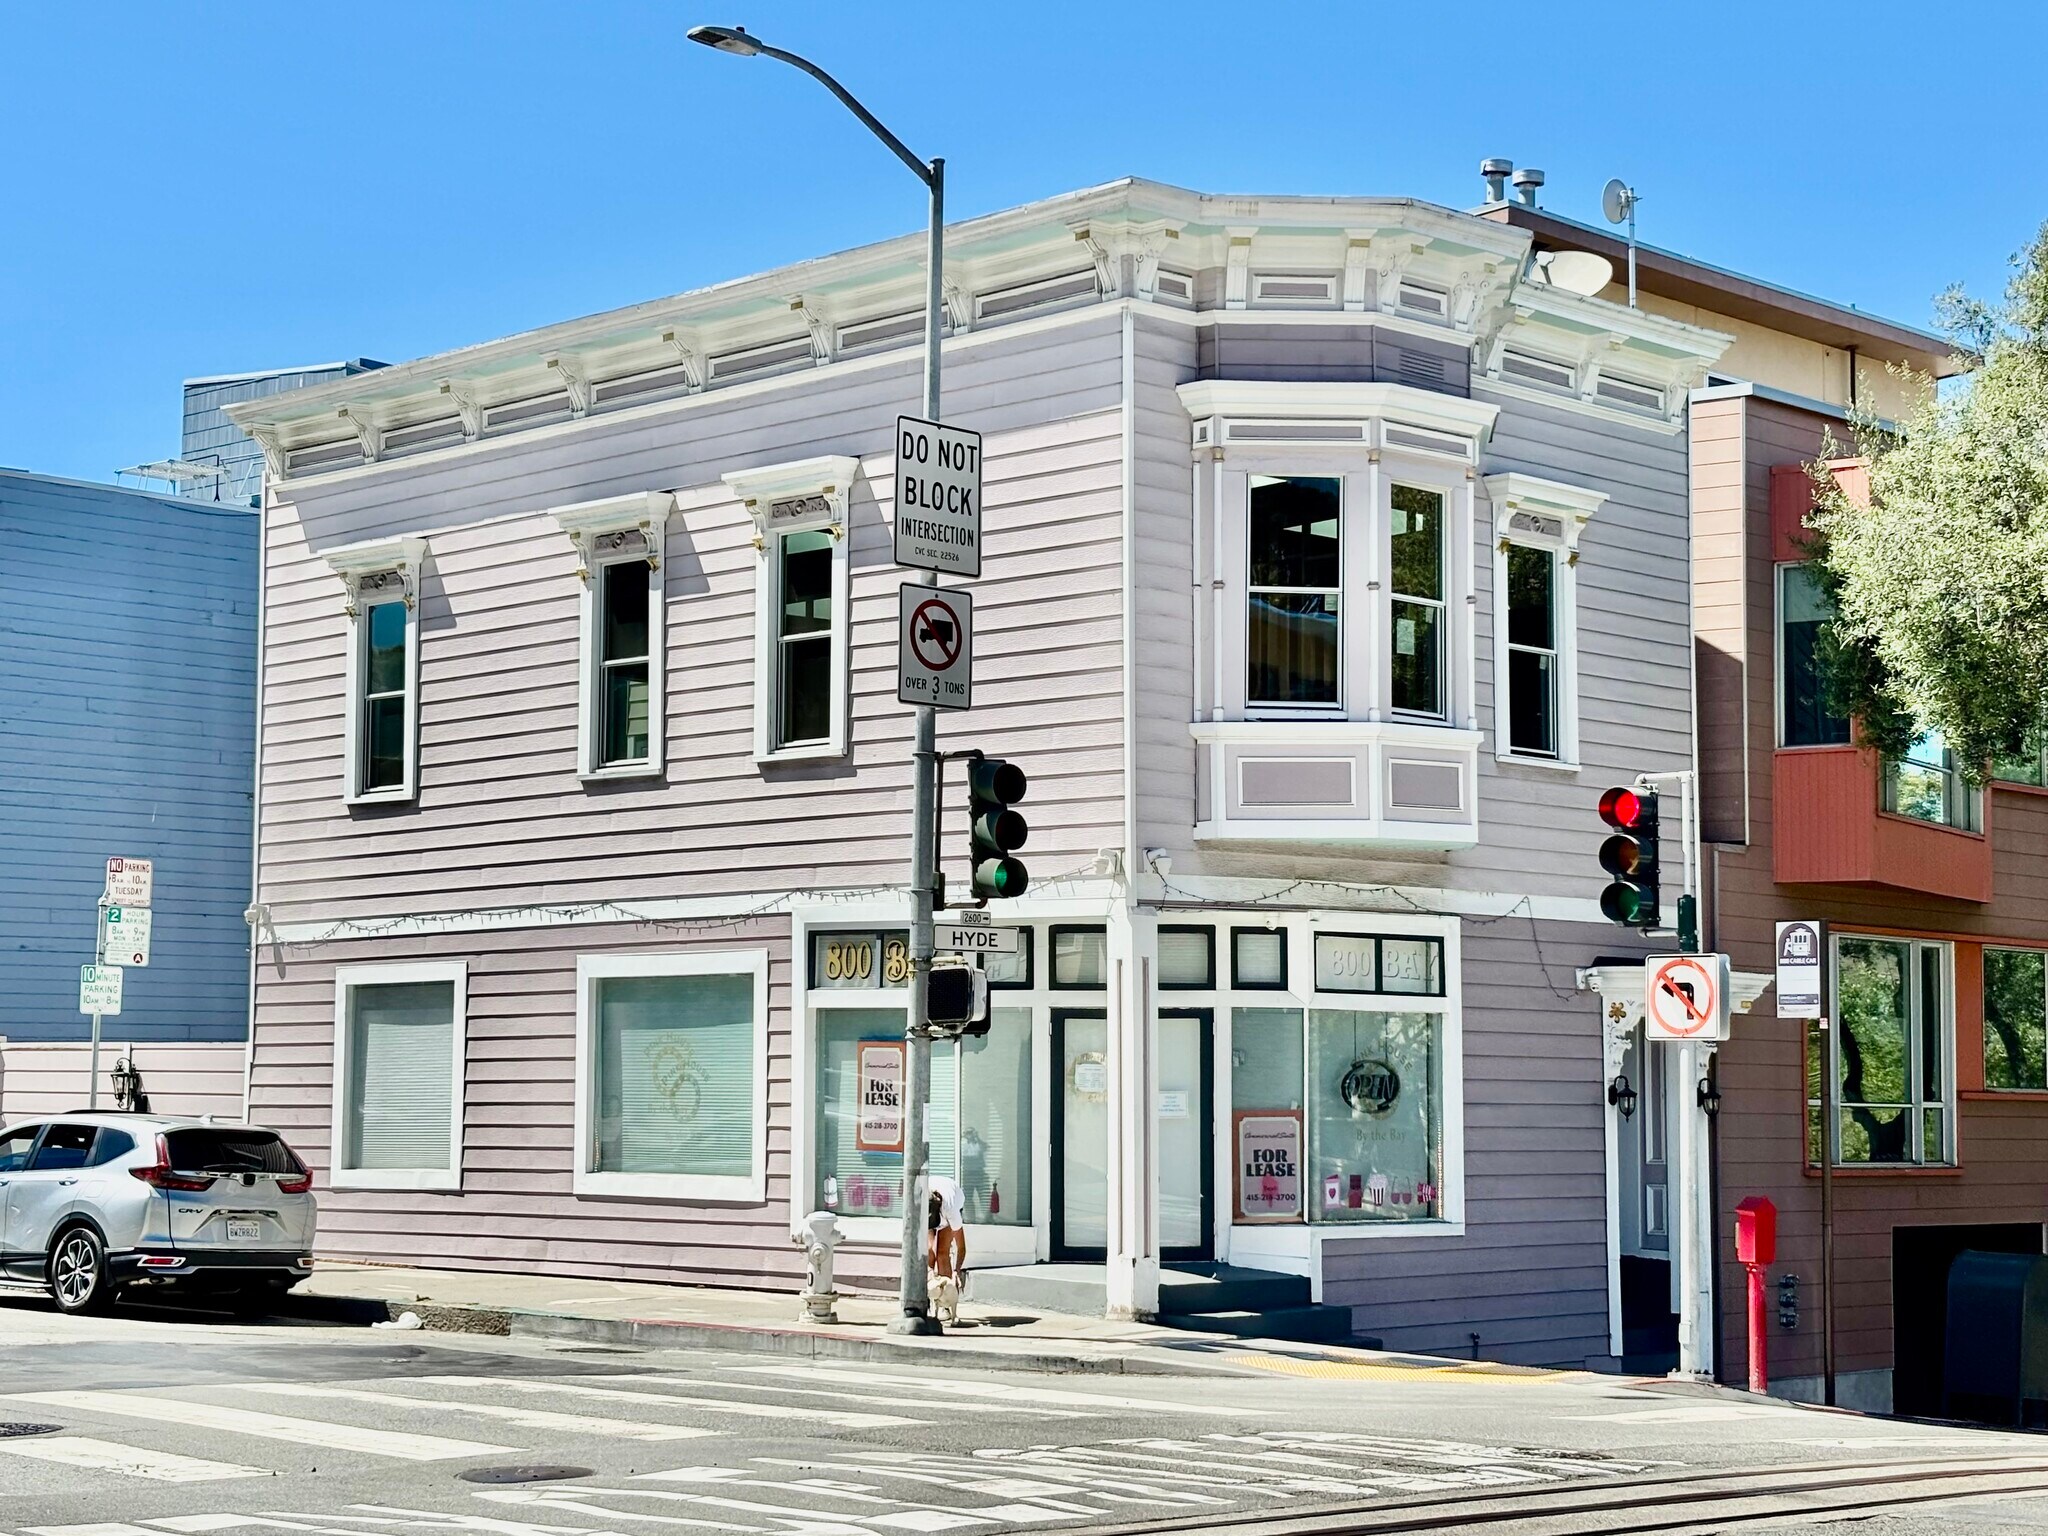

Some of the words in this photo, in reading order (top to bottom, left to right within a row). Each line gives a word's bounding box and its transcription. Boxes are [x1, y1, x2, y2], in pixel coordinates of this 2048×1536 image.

[902, 431, 929, 463] DO
[938, 438, 978, 474] NOT
[905, 476, 973, 517] BLOCK
[901, 516, 974, 548] INTERSECTION
[914, 546, 925, 556] CVC
[940, 551, 960, 562] 22526
[905, 675, 928, 692] OVER
[931, 676, 941, 695] 3
[944, 680, 966, 696] TONS
[110, 859, 122, 872] NO
[124, 863, 150, 874] PARKING
[115, 886, 144, 896] TUESDAY
[110, 909, 120, 921] 2
[122, 917, 149, 926] PARKING
[964, 912, 981, 923] 2600
[952, 930, 999, 948] HYDE
[134, 953, 142, 962] A
[825, 940, 873, 981] 800
[1333, 949, 1372, 977] 800
[1382, 949, 1440, 982] BAY
[83, 967, 95, 982] 10
[96, 973, 120, 983] MINUTE
[84, 984, 118, 994] PARKING
[870, 1079, 893, 1092] FOR
[1349, 1073, 1396, 1100] OPEN
[865, 1092, 899, 1107] LEASE
[1371, 1129, 1386, 1140] the
[1390, 1130, 1407, 1142] Bay
[1253, 1148, 1288, 1163] FOR
[1246, 1163, 1296, 1177] LEASE
